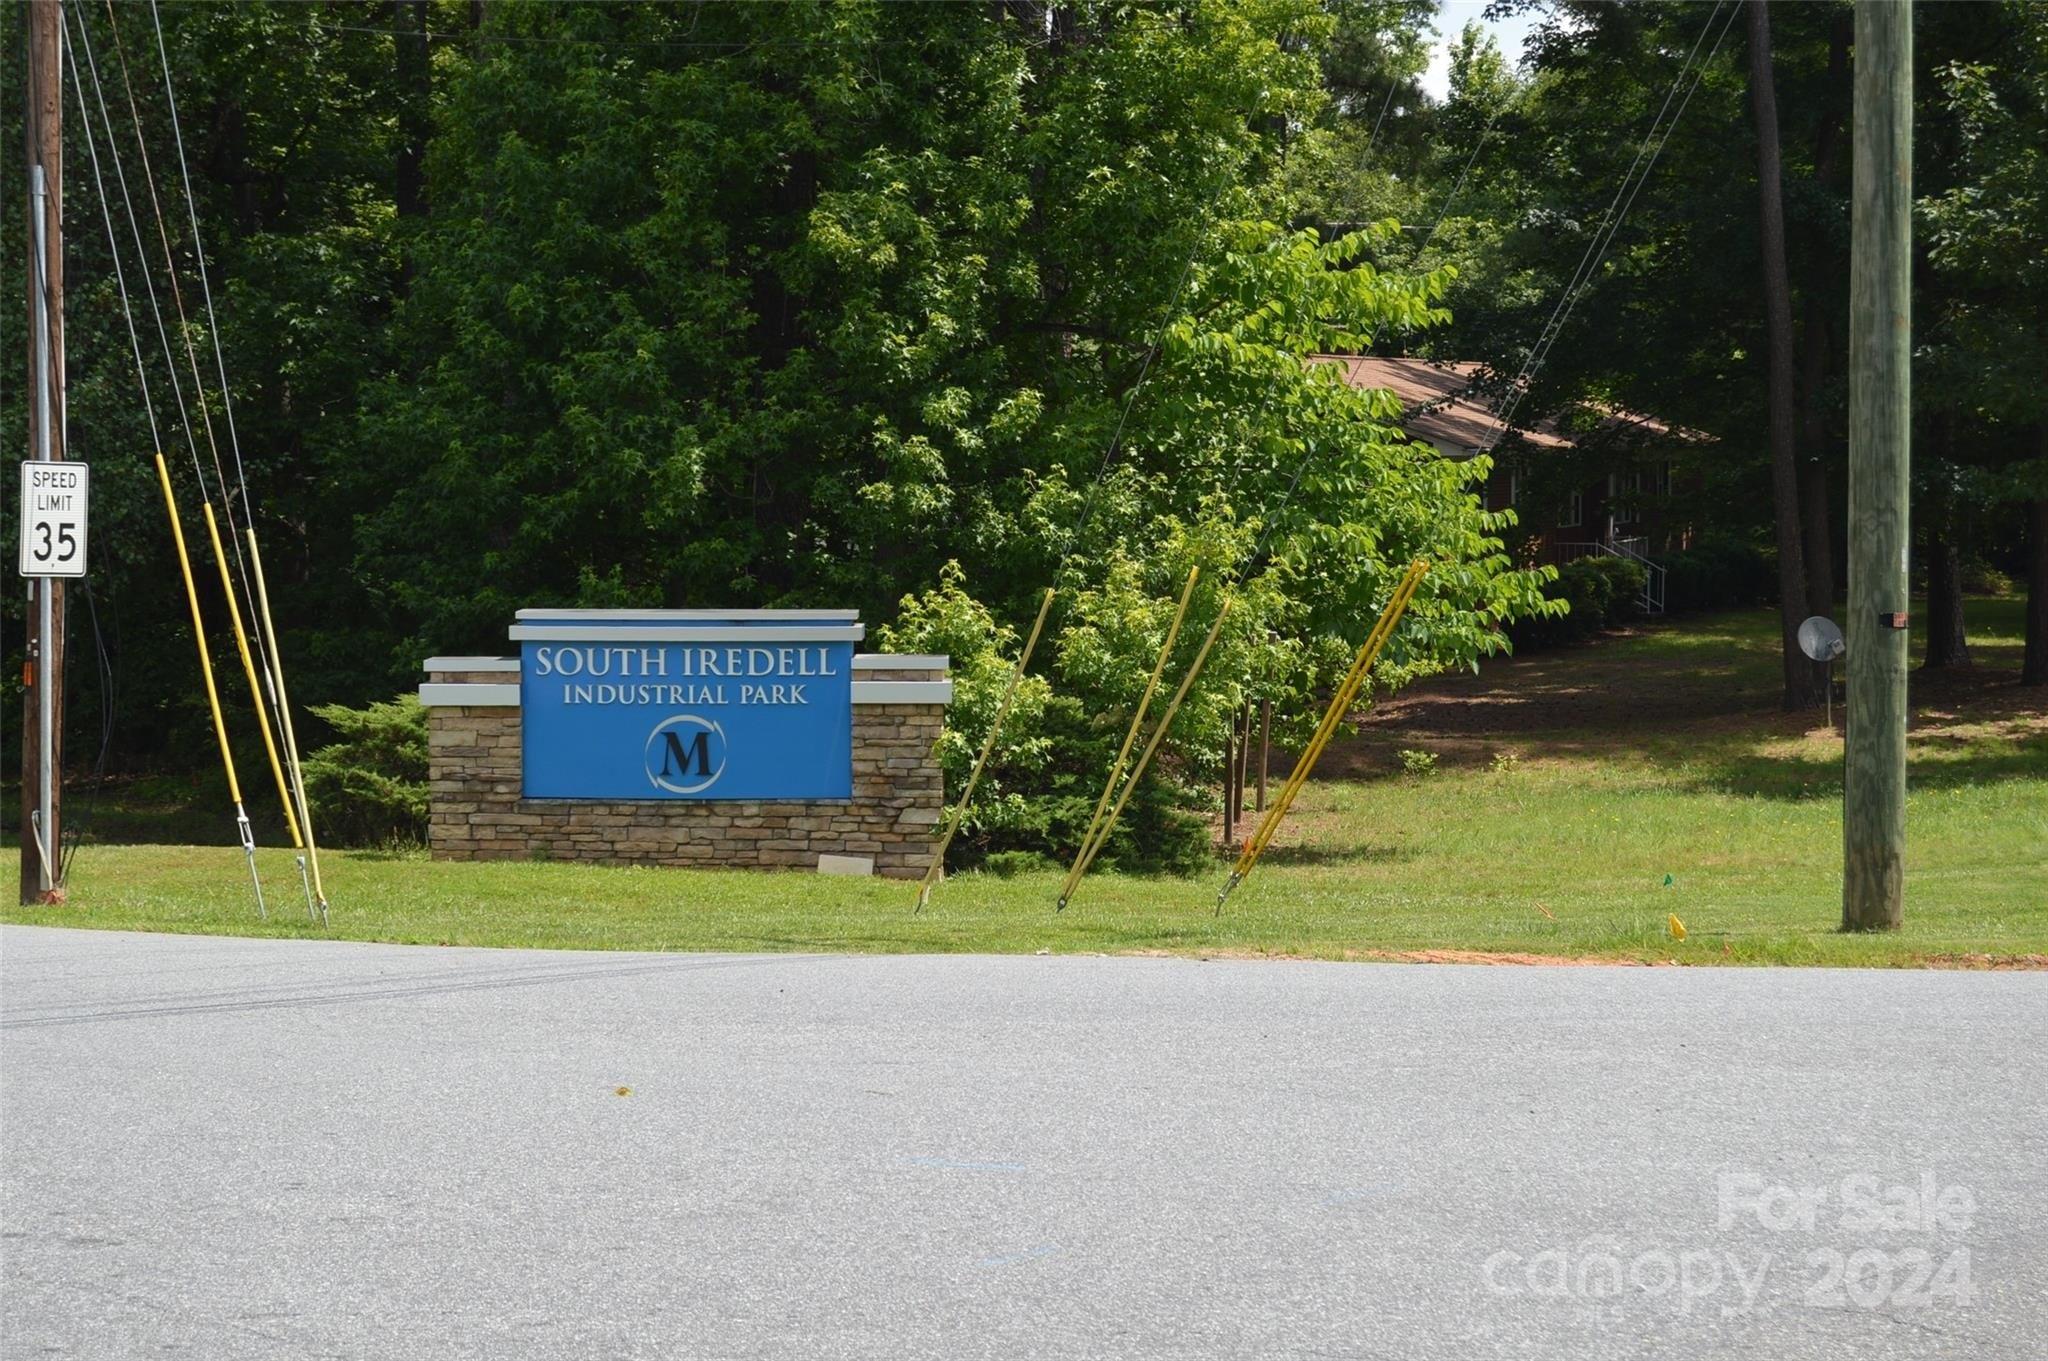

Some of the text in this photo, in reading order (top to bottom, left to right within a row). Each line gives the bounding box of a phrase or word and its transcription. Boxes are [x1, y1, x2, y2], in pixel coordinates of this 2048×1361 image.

[33, 471, 77, 488] SPEED
[38, 495, 72, 511] LIMIT
[33, 521, 76, 561] 35
[535, 647, 836, 676] SOUTH IREDELL
[564, 685, 808, 704] INDUSTRIAL PARK
[659, 731, 714, 776] M
